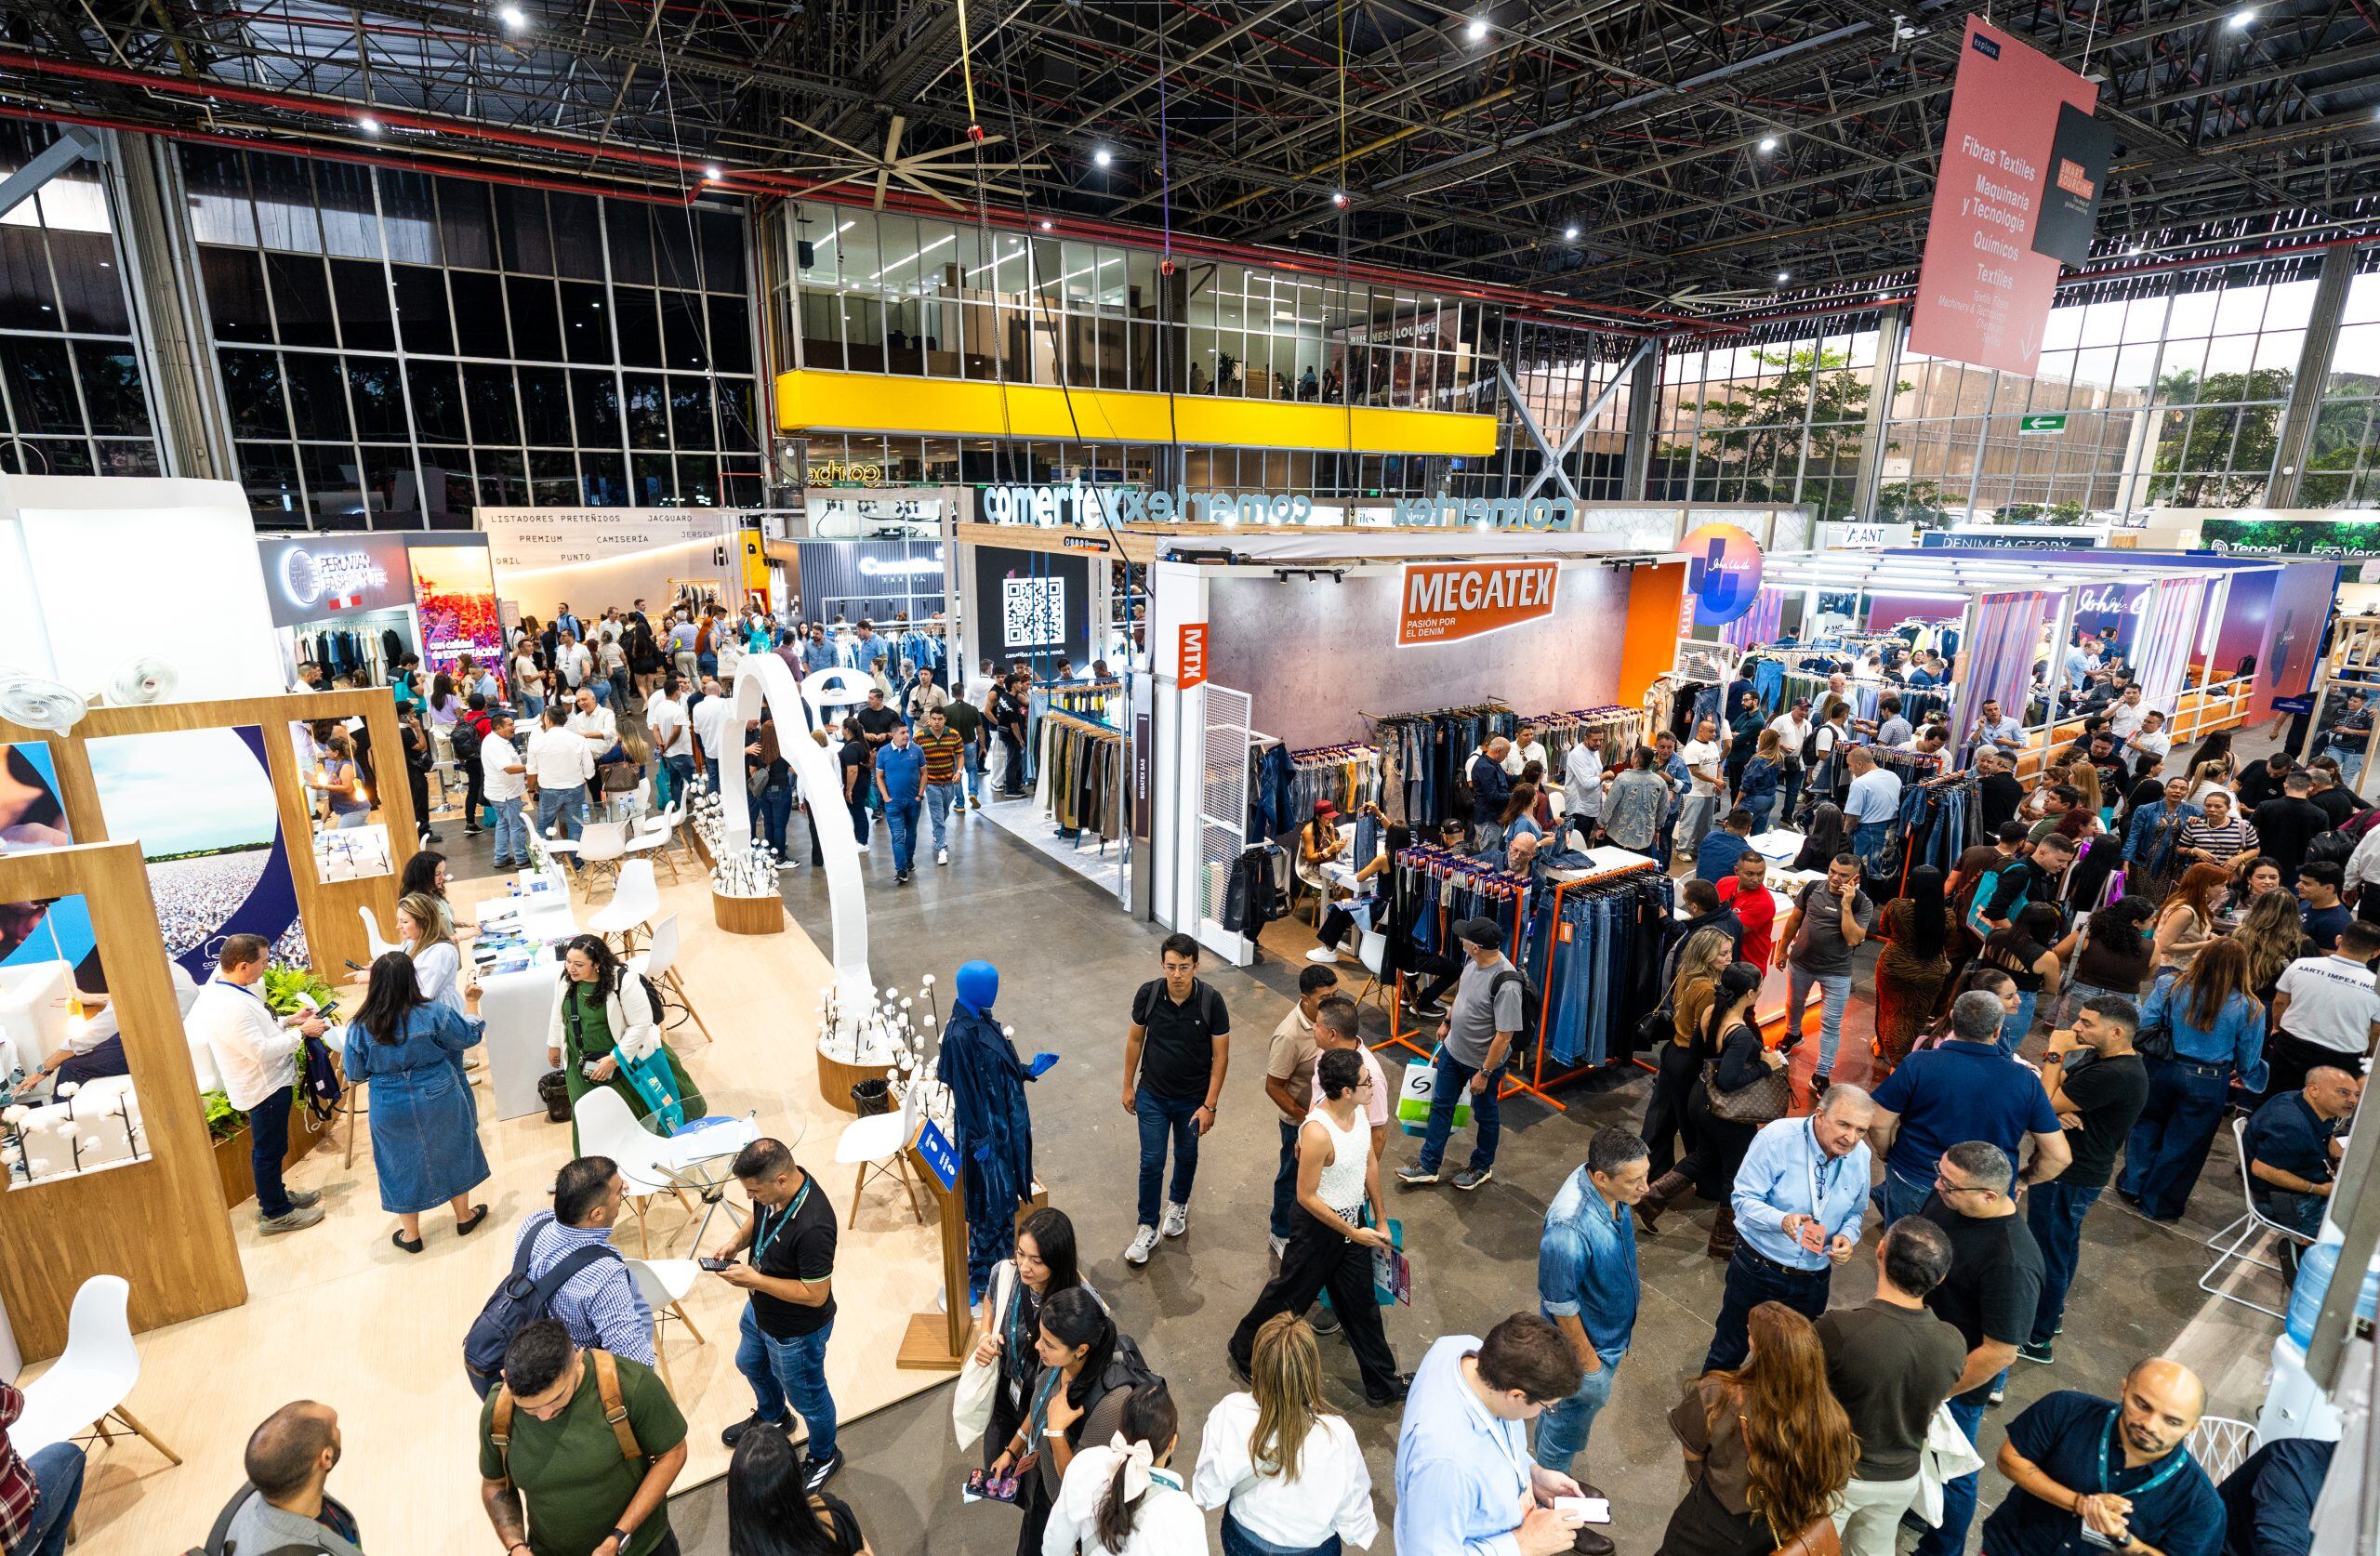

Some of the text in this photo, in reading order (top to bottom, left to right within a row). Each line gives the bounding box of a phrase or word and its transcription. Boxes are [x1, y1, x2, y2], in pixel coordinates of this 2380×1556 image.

[1962, 134, 2036, 181] Fibras Textiles
[2061, 162, 2083, 179] SMART
[1975, 174, 2030, 211] Maquinaria
[2058, 174, 2093, 196] SOURCING
[1961, 196, 2026, 233] y Tecnología
[1974, 230, 2019, 261] Químicos
[1977, 263, 2014, 289] Textiles
[1395, 322, 1436, 339] LOUNGE
[983, 477, 1124, 531] comertex
[491, 515, 554, 523] LISTADORES
[561, 513, 621, 523] PRETEÑIDOS
[596, 534, 649, 544] CAMISERÍA
[2230, 543, 2282, 553] Tencel
[320, 554, 371, 573] PERUVIAN
[561, 553, 591, 561] PUNTO
[324, 572, 368, 590] FASHN
[1408, 567, 1554, 614] MEGATEX
[1407, 617, 1456, 629] PASIÓN POR
[1680, 597, 1694, 635] MTX
[1406, 627, 1445, 638] EL DENIM
[1183, 628, 1202, 679] MTX
[2297, 966, 2325, 976] AARTI
[2327, 972, 2357, 984] IMPEX
